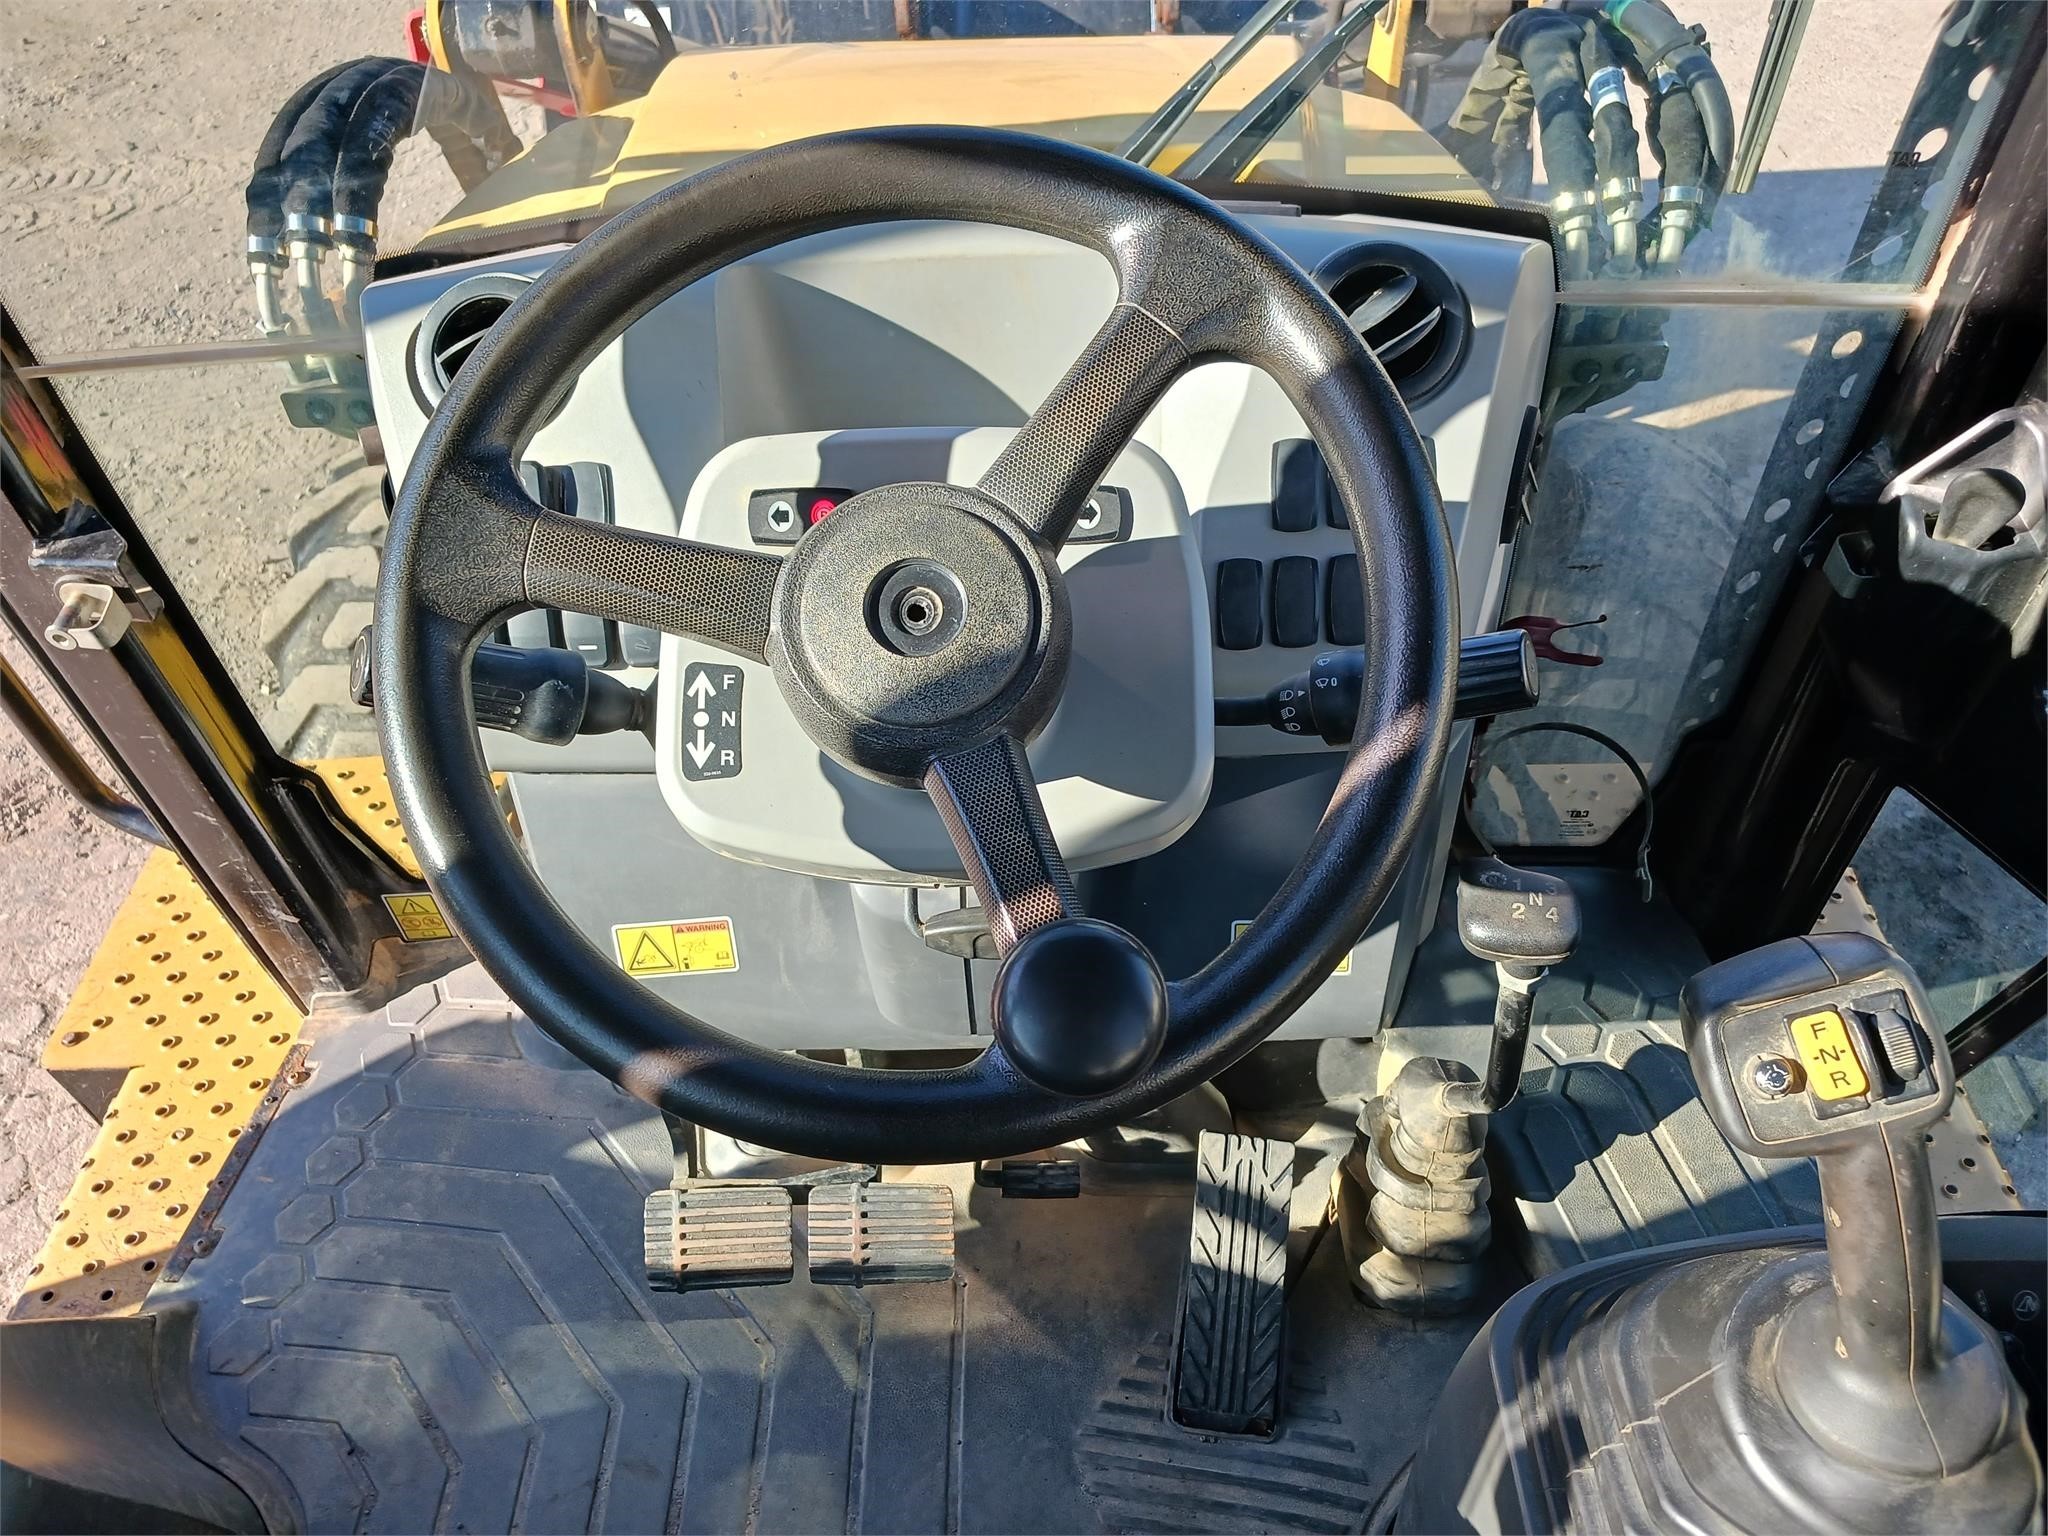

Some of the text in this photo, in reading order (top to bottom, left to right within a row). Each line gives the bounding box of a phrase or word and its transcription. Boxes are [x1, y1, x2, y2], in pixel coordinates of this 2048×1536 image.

[723, 674, 736, 690] F
[721, 711, 736, 727] N
[720, 749, 735, 766] R
[1529, 892, 1543, 907] N
[1511, 902, 1526, 921] 2
[1545, 906, 1560, 923] 4
[685, 924, 727, 933] WARNING
[1810, 1021, 1826, 1040] F
[1829, 1070, 1851, 1089] R
